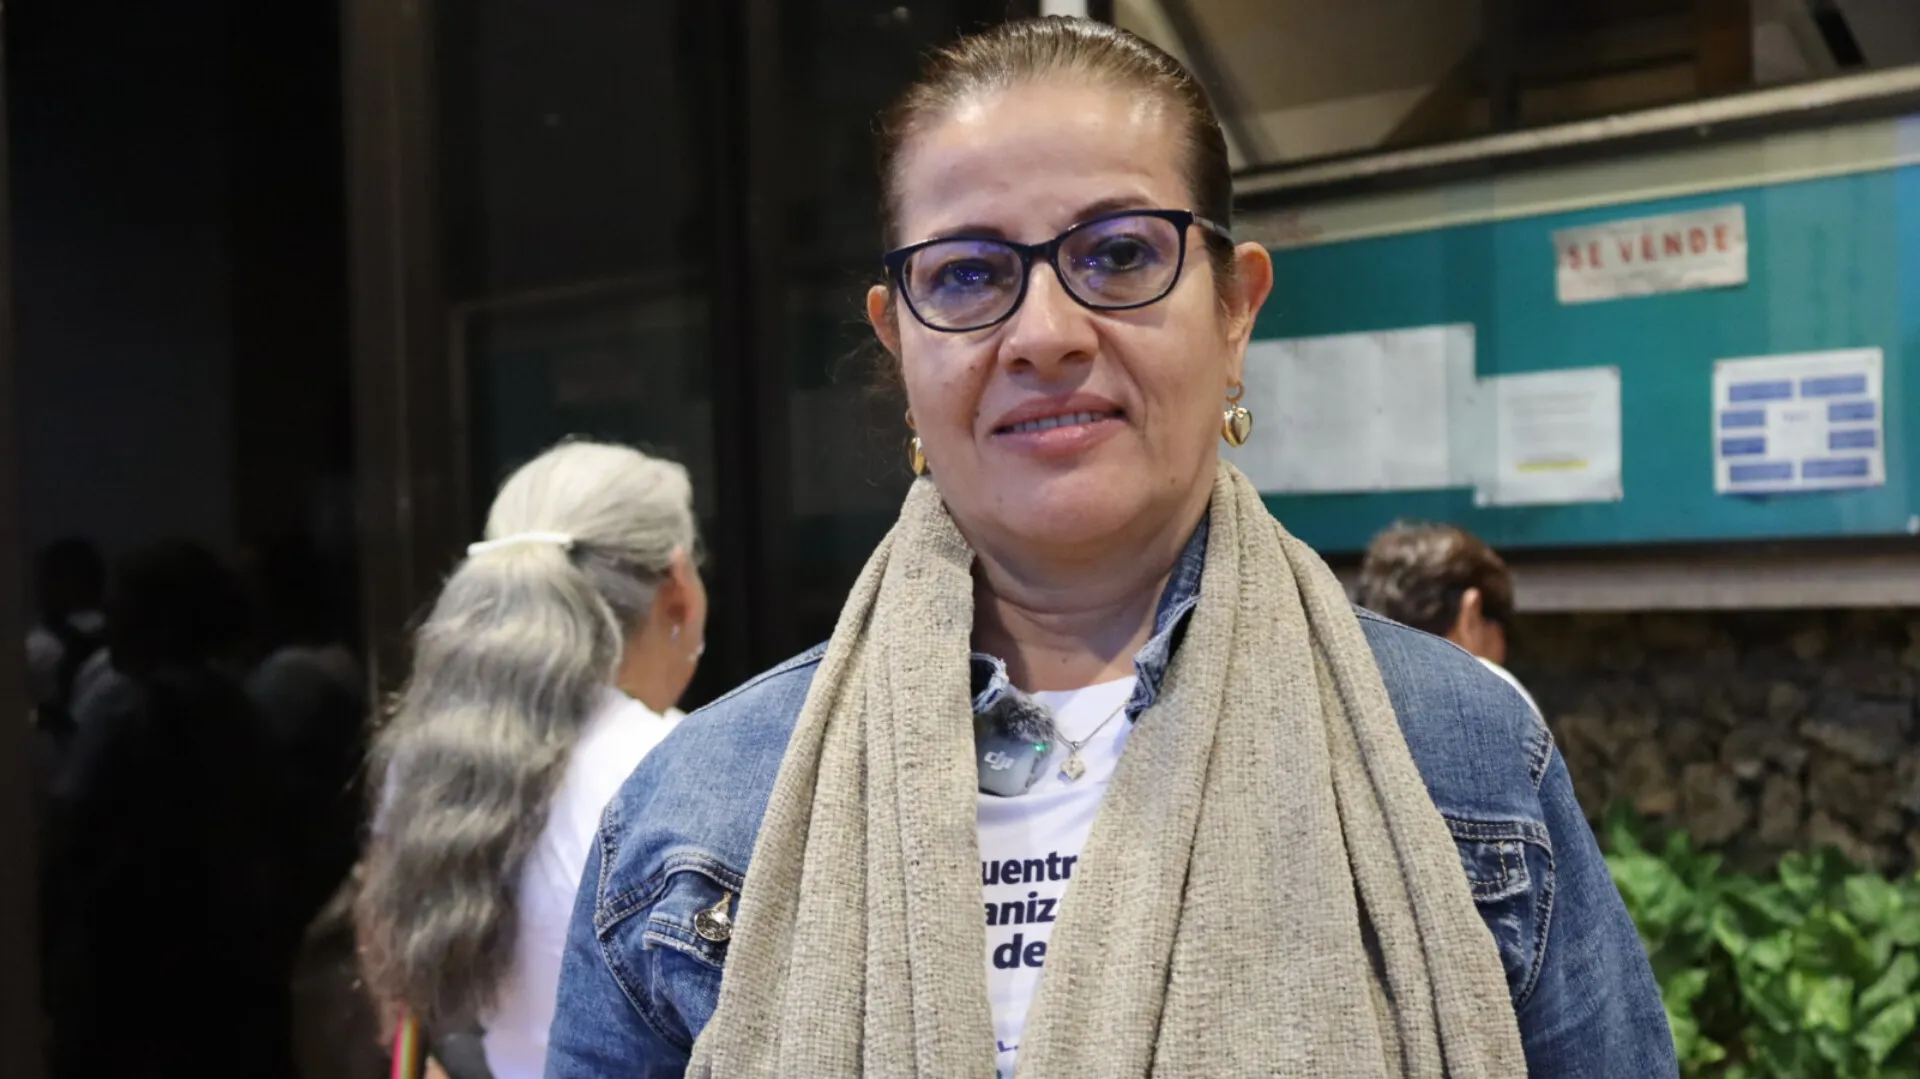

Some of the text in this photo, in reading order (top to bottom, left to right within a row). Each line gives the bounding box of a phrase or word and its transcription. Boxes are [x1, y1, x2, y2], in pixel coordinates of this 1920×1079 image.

[1567, 223, 1730, 271] SE VENDE
[993, 933, 1047, 969] de
